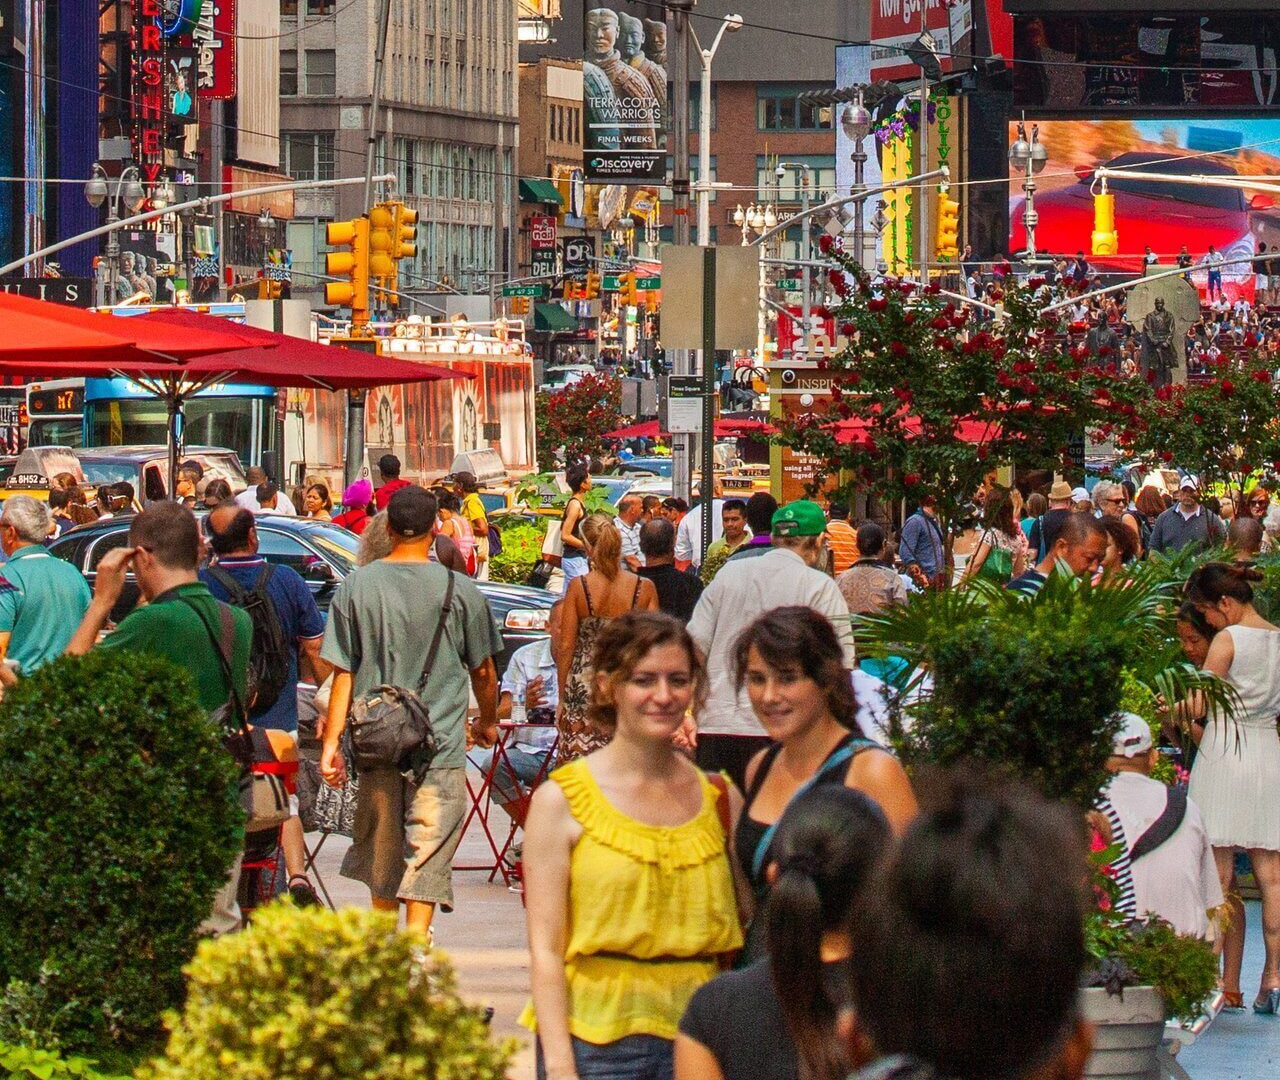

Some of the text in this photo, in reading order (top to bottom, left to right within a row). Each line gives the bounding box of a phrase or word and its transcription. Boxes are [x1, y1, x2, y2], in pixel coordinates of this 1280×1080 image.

[589, 97, 660, 108] TERRACOTTA
[601, 108, 661, 119] WARRIORS
[597, 135, 652, 143] FINAL WEEKS
[532, 228, 555, 241] nail
[532, 262, 555, 276] DELI
[518, 287, 526, 295] 49
[56, 390, 74, 410] M7
[18, 475, 38, 484] 8H52
